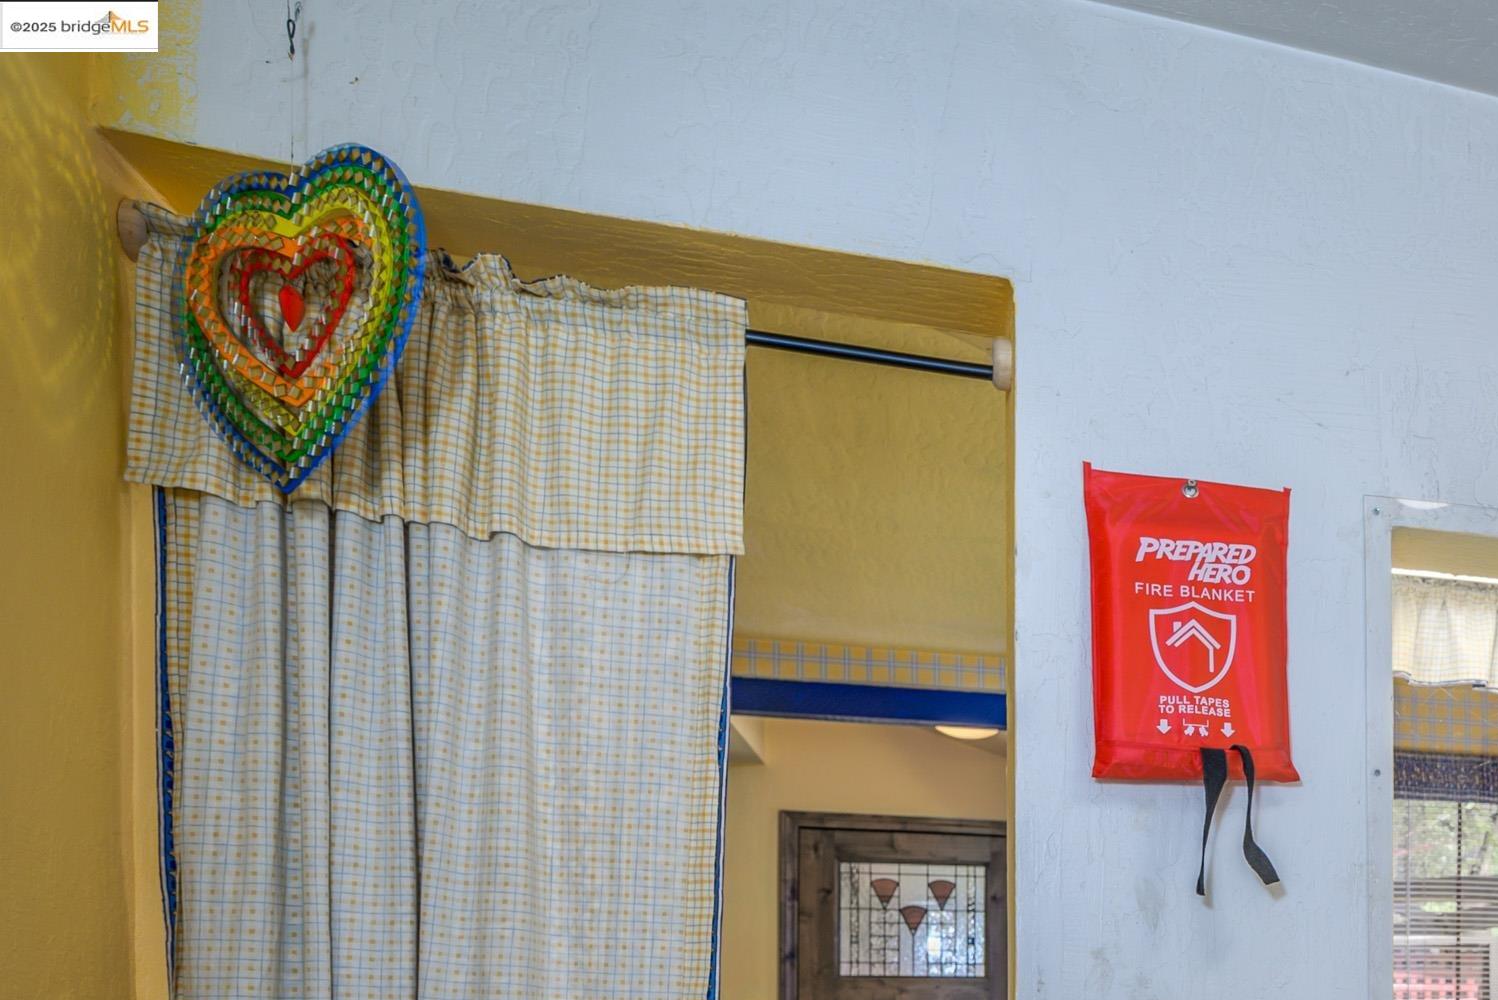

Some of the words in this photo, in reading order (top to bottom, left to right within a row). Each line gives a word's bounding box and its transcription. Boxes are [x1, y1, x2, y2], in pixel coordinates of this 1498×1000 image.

[1136, 537, 1257, 564] PREPARED
[1187, 561, 1251, 585] HERO
[1135, 582, 1174, 597] FIRE
[1180, 585, 1255, 602] BLANKET
[1158, 705, 1174, 713] TO
[1178, 705, 1231, 717] RELEASE
[1160, 695, 1190, 705] PULL
[1194, 695, 1230, 708] TAPES
